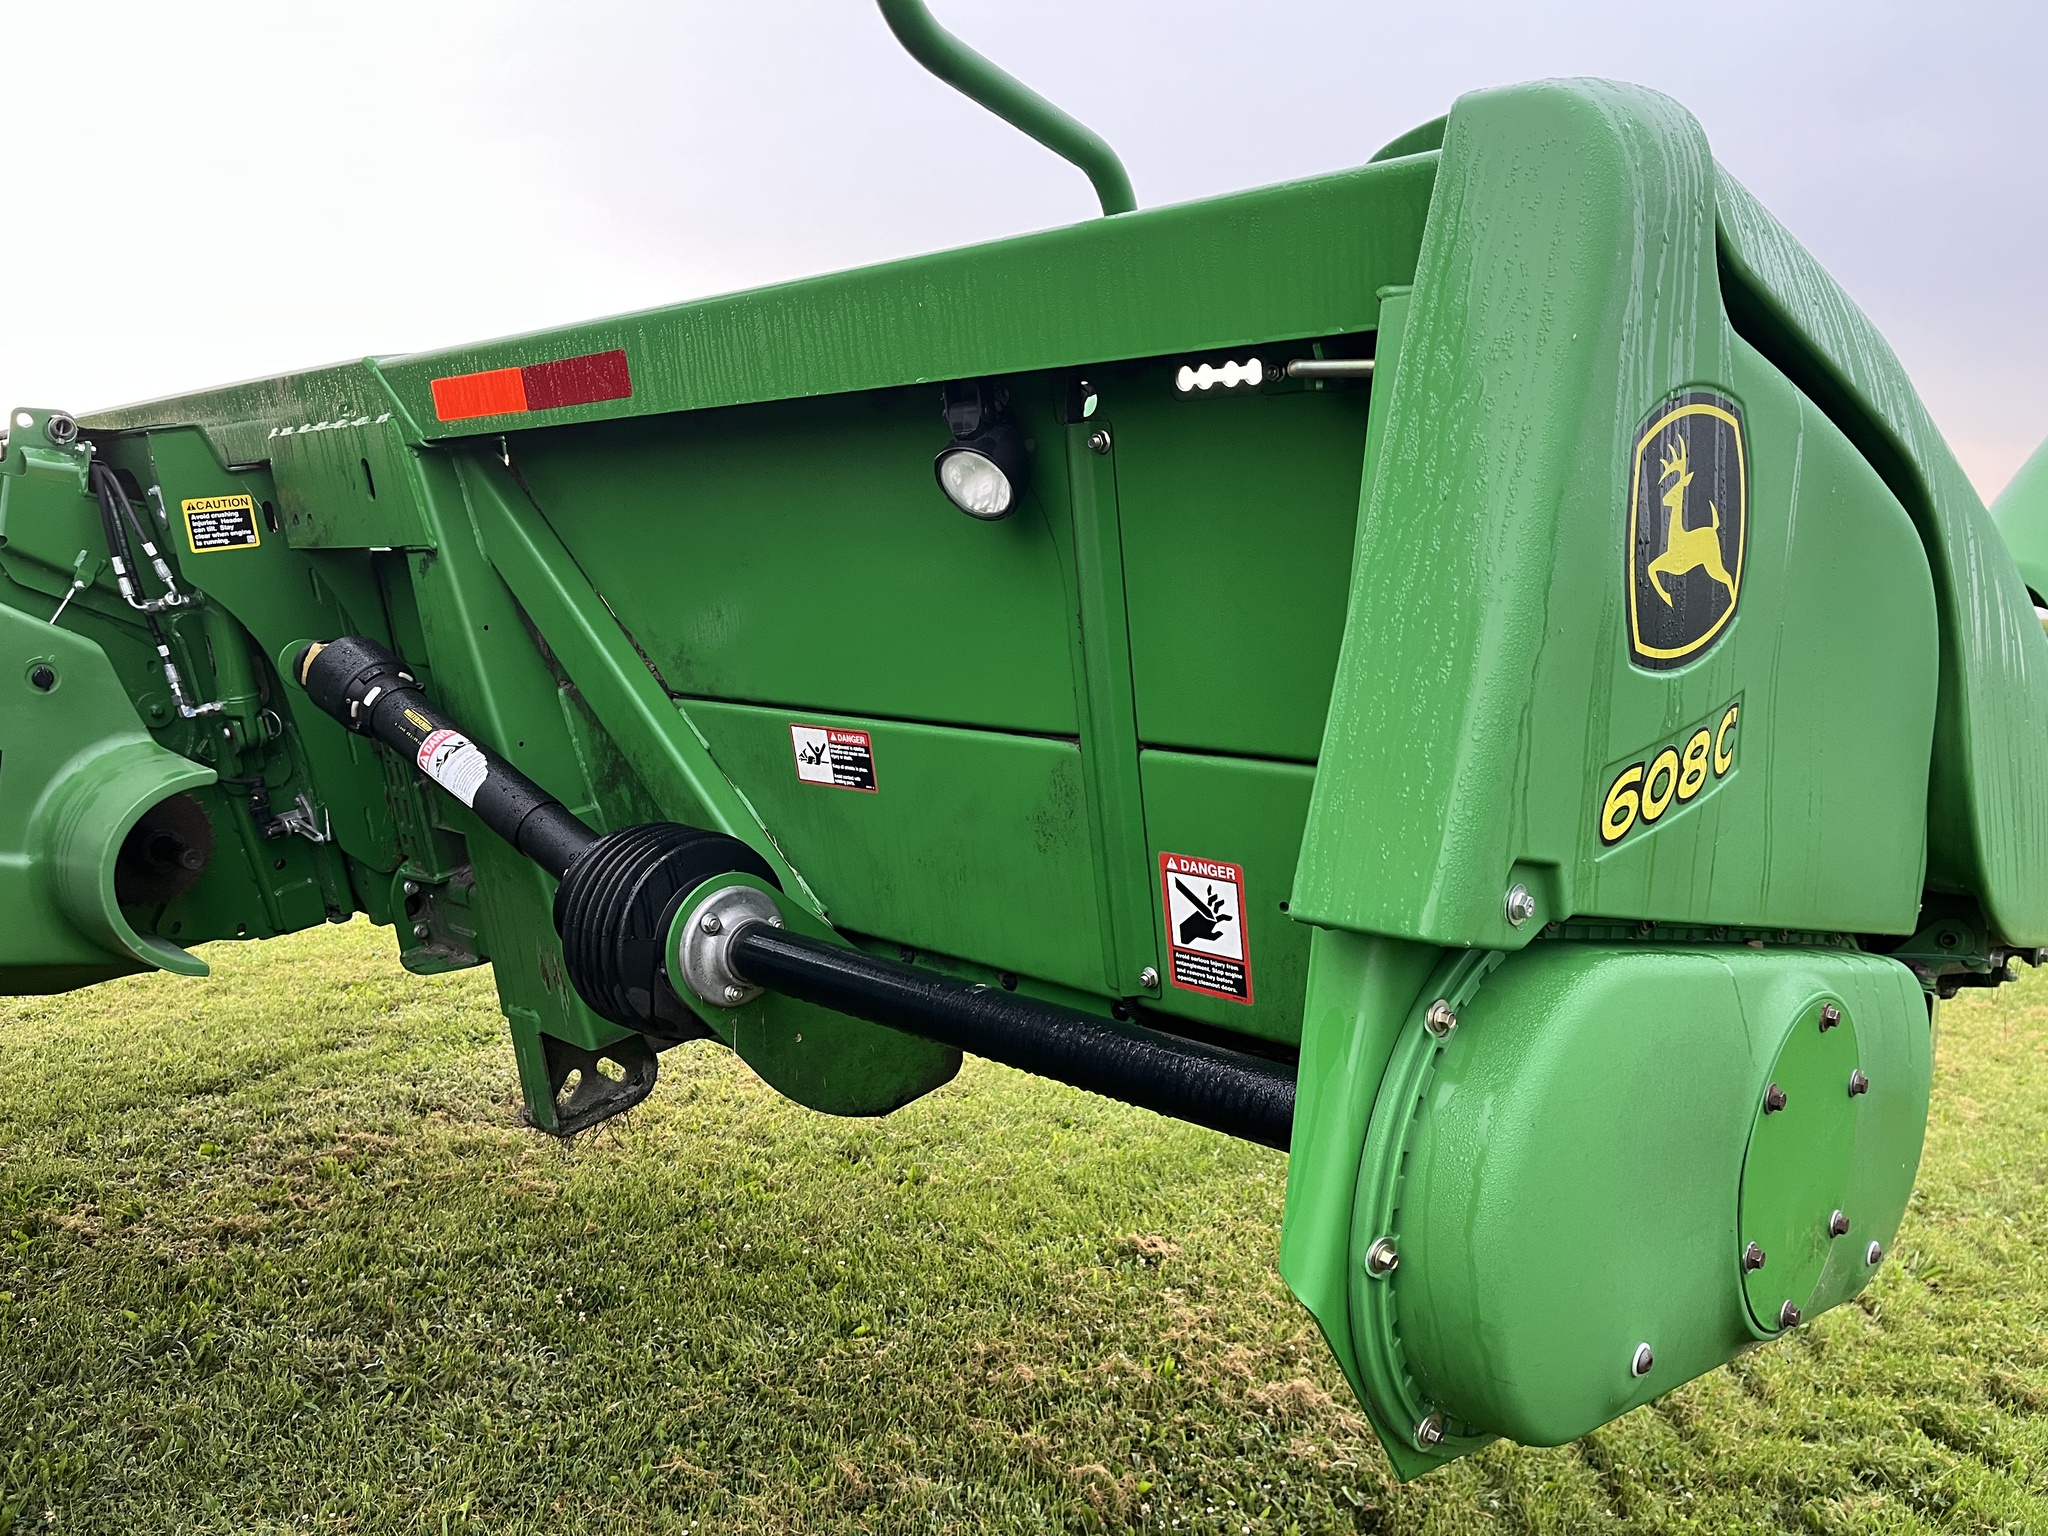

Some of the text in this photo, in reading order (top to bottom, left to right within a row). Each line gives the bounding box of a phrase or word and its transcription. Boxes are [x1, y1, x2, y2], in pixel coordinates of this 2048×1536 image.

[196, 498, 248, 510] CAUTION
[838, 734, 865, 744] DANGER
[1601, 703, 1739, 847] 608C
[1181, 859, 1235, 880] DANGER
[1176, 952, 1190, 960] Avoid
[1176, 960, 1210, 972] entanglement.
[1212, 968, 1224, 976] Stop
[1177, 975, 1197, 984] opening
[1221, 985, 1238, 993] doors.
[1187, 970, 1205, 978] remove
[1216, 976, 1233, 984] before
